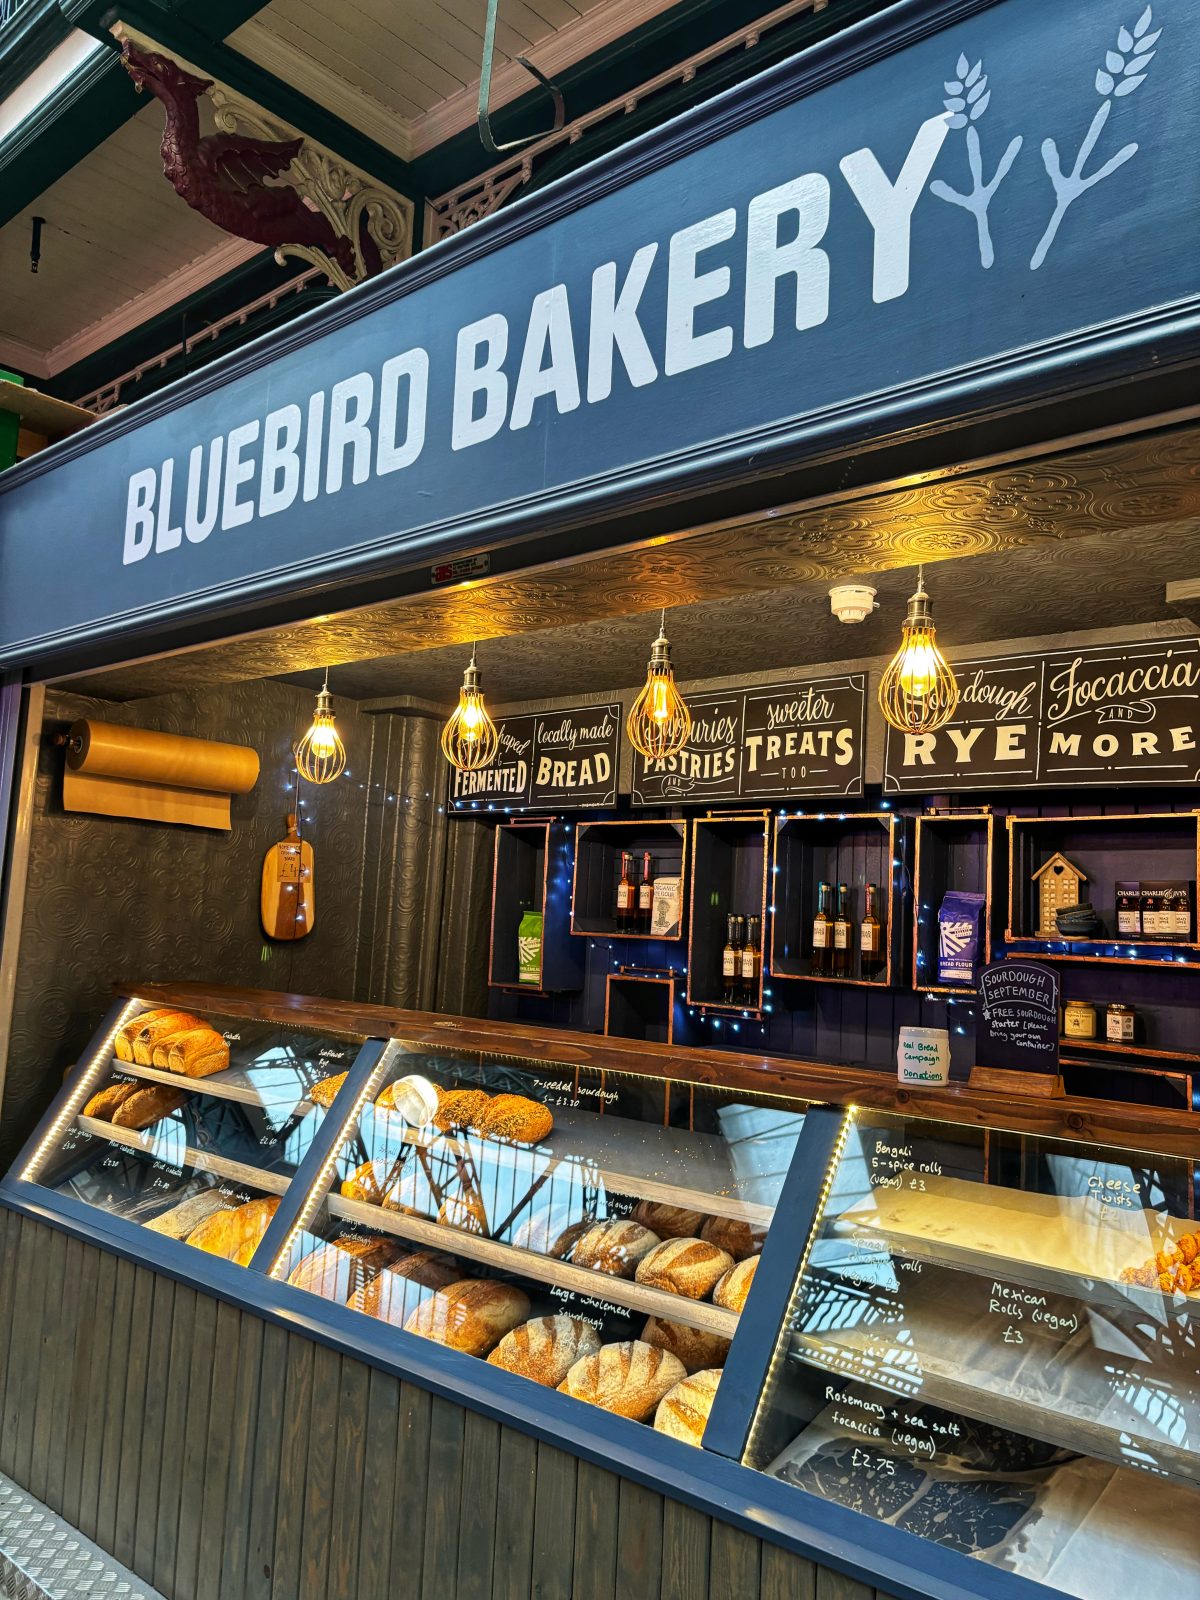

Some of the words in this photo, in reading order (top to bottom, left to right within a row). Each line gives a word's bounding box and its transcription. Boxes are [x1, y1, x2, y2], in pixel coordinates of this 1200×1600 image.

[123, 347, 430, 566] BLUEBIRD
[452, 111, 954, 451] BAKERY
[1047, 650, 1200, 720] Focaccia
[767, 687, 835, 730] sweeter
[1108, 708, 1134, 720] AND
[495, 724, 531, 756] haped
[537, 719, 578, 750] locally
[580, 714, 614, 740] made
[1049, 726, 1197, 757] MORE
[745, 728, 853, 772] TREATS
[902, 724, 1027, 766] RYE
[535, 752, 611, 787] BREAD
[643, 746, 736, 779] PASTRIES
[782, 766, 806, 779] TOO
[454, 759, 527, 798] FERMENTED
[985, 971, 1046, 987] SOURDOUGH
[988, 986, 1050, 1005] SEPTEMBER
[991, 1019, 1020, 1028] starter
[992, 1008, 1014, 1018] FREE
[1016, 1009, 1057, 1024] SOURDOUGH
[917, 1042, 939, 1052] Bread
[990, 1029, 1008, 1042] bring
[1010, 1032, 1027, 1040] your
[1027, 1033, 1041, 1041] own
[904, 1052, 940, 1065] Campaign
[903, 1069, 942, 1080] Donations
[533, 1080, 573, 1092] 7-seeded
[577, 1086, 619, 1104] sourdough
[875, 1141, 913, 1157] Bengali
[872, 1157, 915, 1172] 5-spice
[920, 1161, 942, 1176] rolls
[870, 1173, 903, 1190] (vegan)
[909, 1179, 926, 1191] £3
[1088, 1176, 1141, 1194] Cheese
[1091, 1190, 1132, 1207] Twists
[900, 1260, 922, 1274] rolls
[550, 1284, 575, 1303] Large
[580, 1296, 631, 1318] wholemeal
[991, 1281, 1047, 1306] Mexican
[989, 1299, 1023, 1320] Rolls
[1031, 1308, 1078, 1334] (vegan)
[1002, 1325, 1024, 1344] £3
[825, 1386, 885, 1420] Rosemary
[904, 1414, 928, 1429] sea
[932, 1422, 960, 1437] salt
[832, 1411, 880, 1437] focaccia
[891, 1428, 936, 1460] (vegan)
[851, 1448, 895, 1476] £2.75
